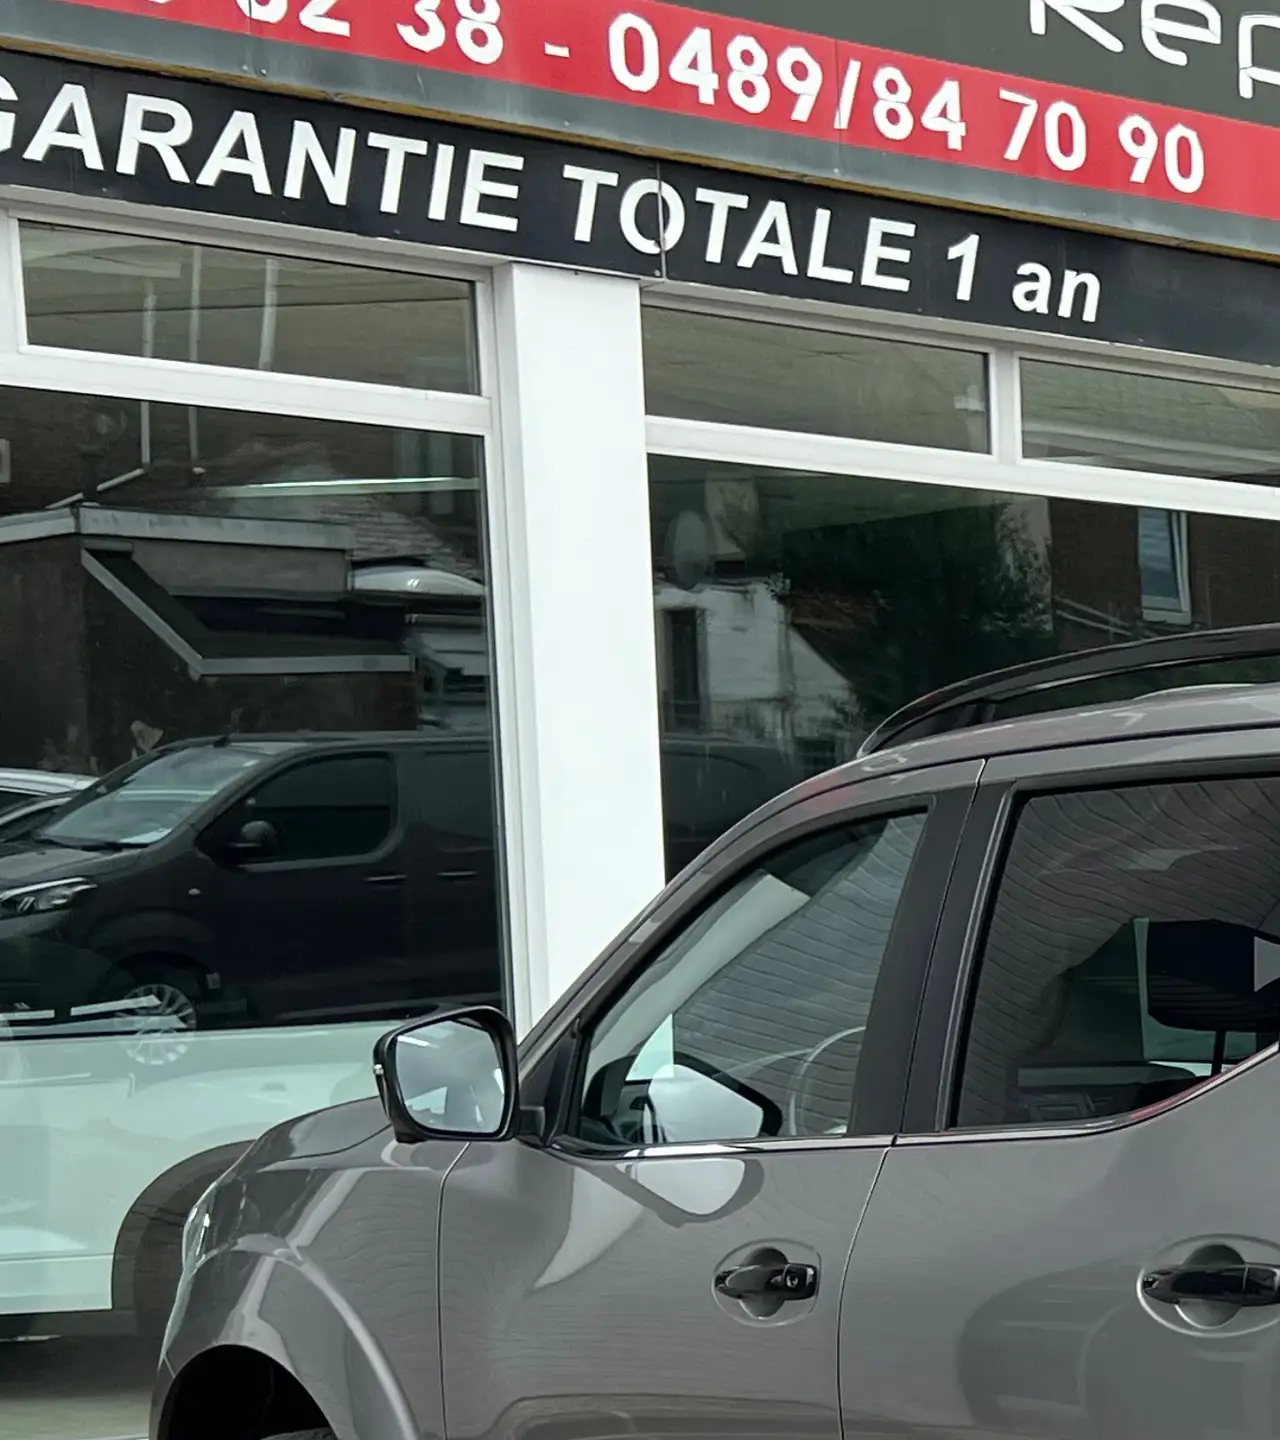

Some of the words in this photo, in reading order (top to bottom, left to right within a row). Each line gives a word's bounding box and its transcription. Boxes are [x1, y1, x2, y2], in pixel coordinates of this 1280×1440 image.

[608, 12, 966, 152] 0489/84
[999, 88, 1088, 173] 70
[1118, 114, 1206, 194] 90
[562, 163, 919, 296] TOTALE
[946, 232, 982, 302] 1
[1011, 261, 1101, 324] an
